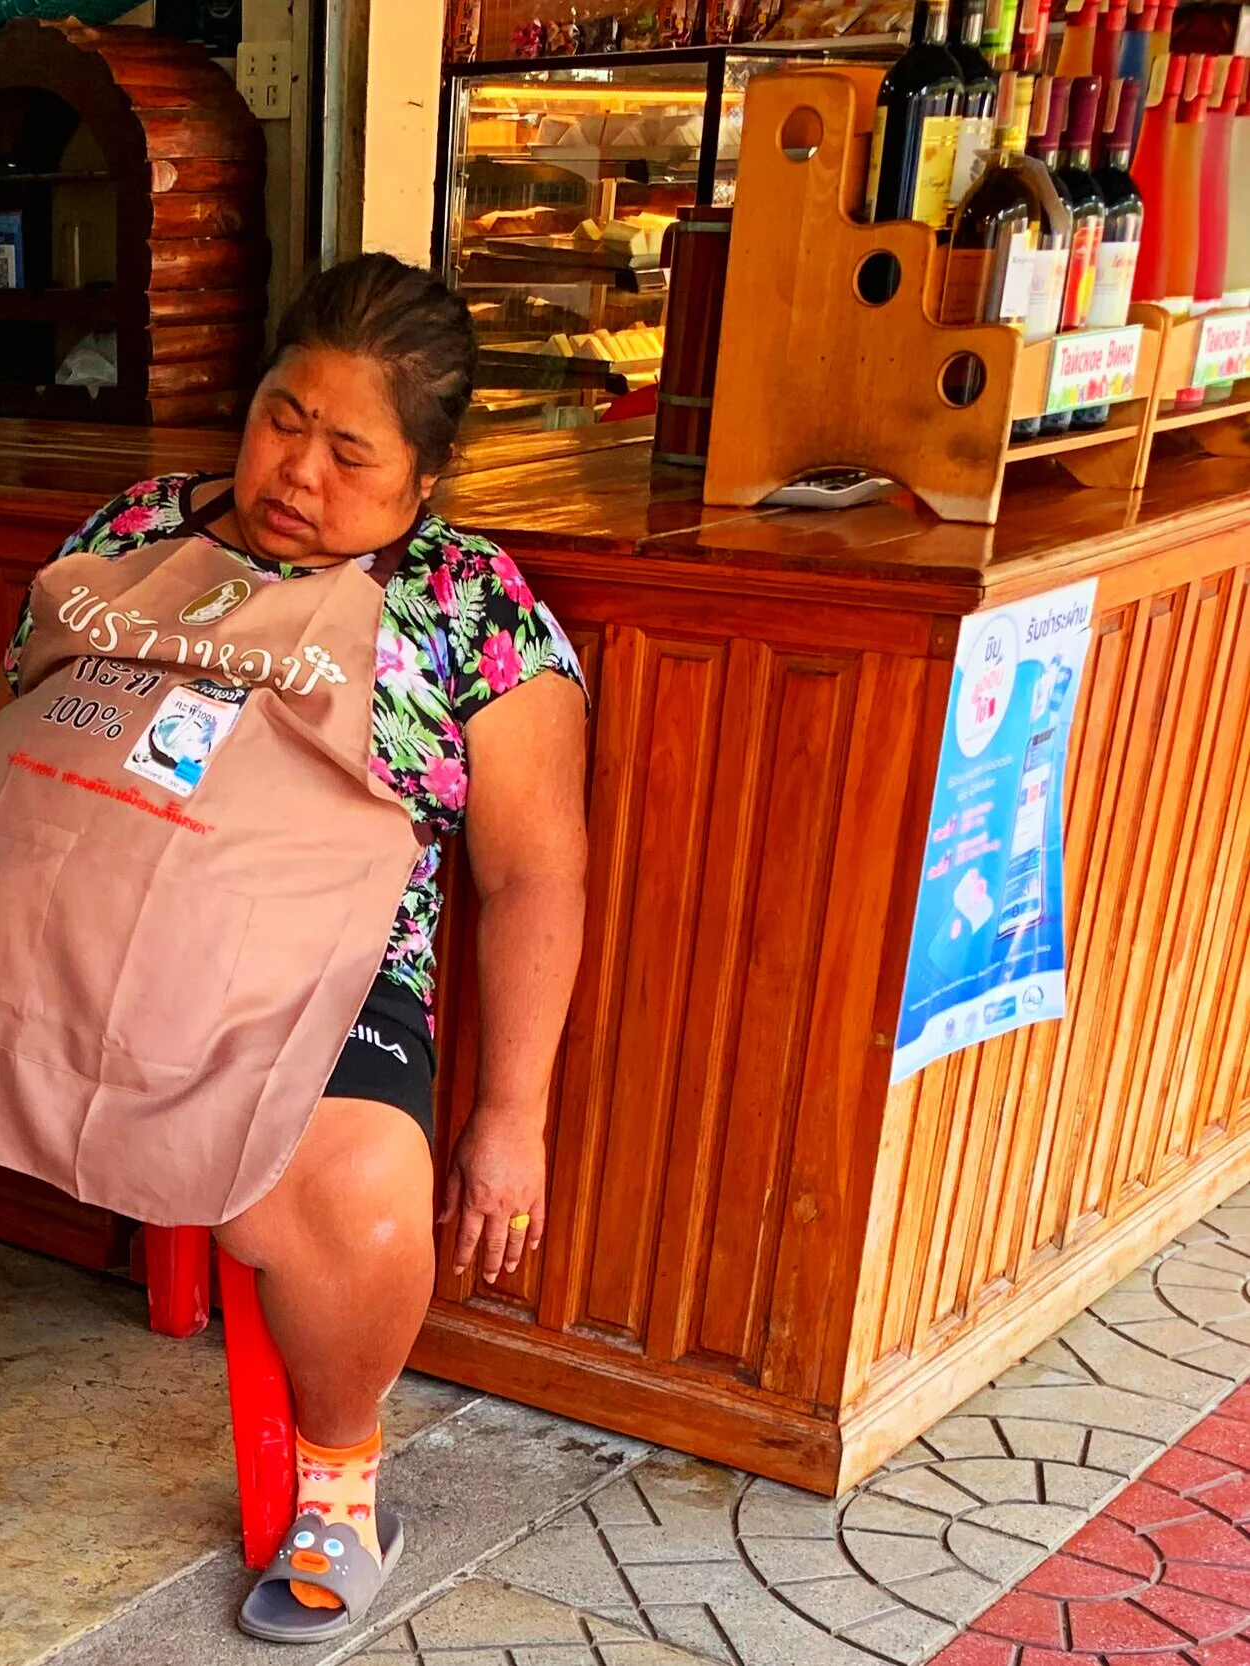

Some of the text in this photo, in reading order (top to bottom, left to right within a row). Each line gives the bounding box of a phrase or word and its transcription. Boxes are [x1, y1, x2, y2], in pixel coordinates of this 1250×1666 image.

[1060, 339, 1134, 377] Тайское Вино
[58, 585, 323, 696] พร้าวหอม
[1025, 601, 1089, 644] รับชำระผ่าน
[74, 655, 168, 698] กะท
[41, 694, 133, 740] 100%
